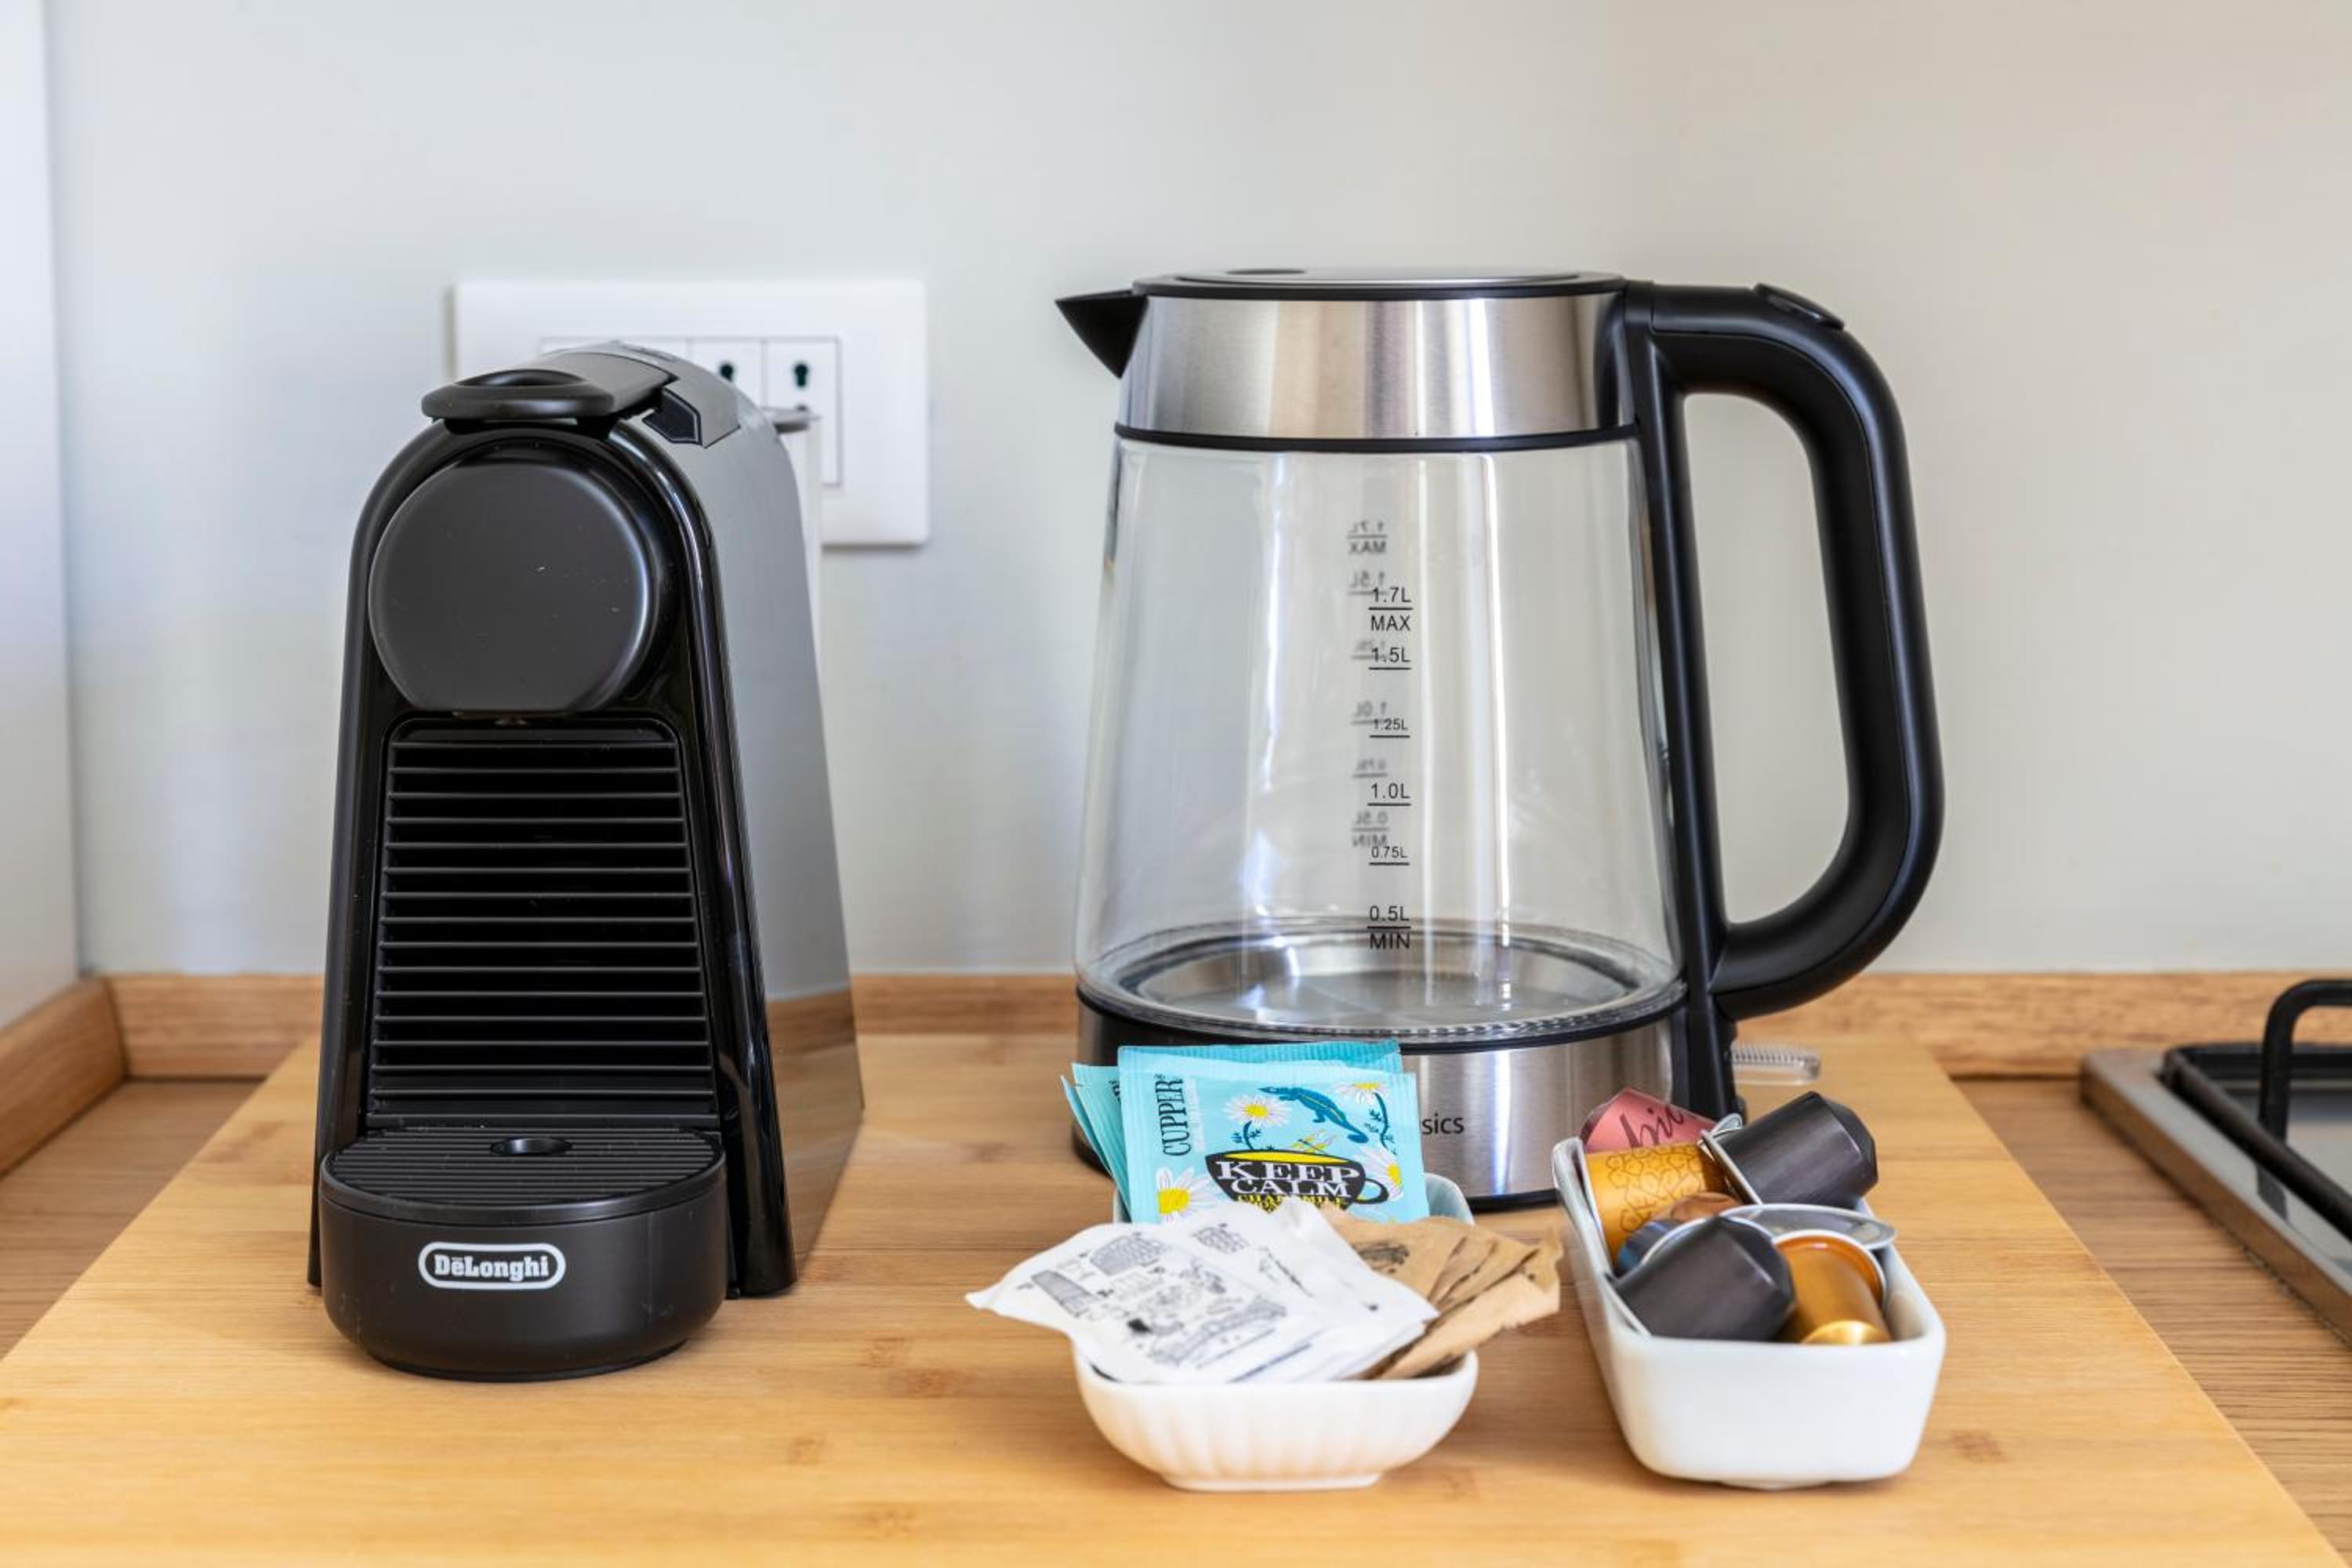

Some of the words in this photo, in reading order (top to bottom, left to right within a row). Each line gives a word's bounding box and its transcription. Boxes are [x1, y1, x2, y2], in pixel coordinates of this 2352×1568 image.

[1371, 586, 1412, 603] 1.7L
[1370, 615, 1411, 631] MAX
[1371, 647, 1412, 662] 1.5L
[1372, 718, 1409, 731] 1.25L
[1370, 782, 1411, 799] 1.0L
[1371, 845, 1408, 858] 0.75L
[1369, 906, 1411, 922] 0.5L
[1370, 933, 1410, 950] MIN
[1421, 1112, 1465, 1135] sics
[1215, 1160, 1361, 1185] KEEP
[1230, 1178, 1352, 1198] CALM
